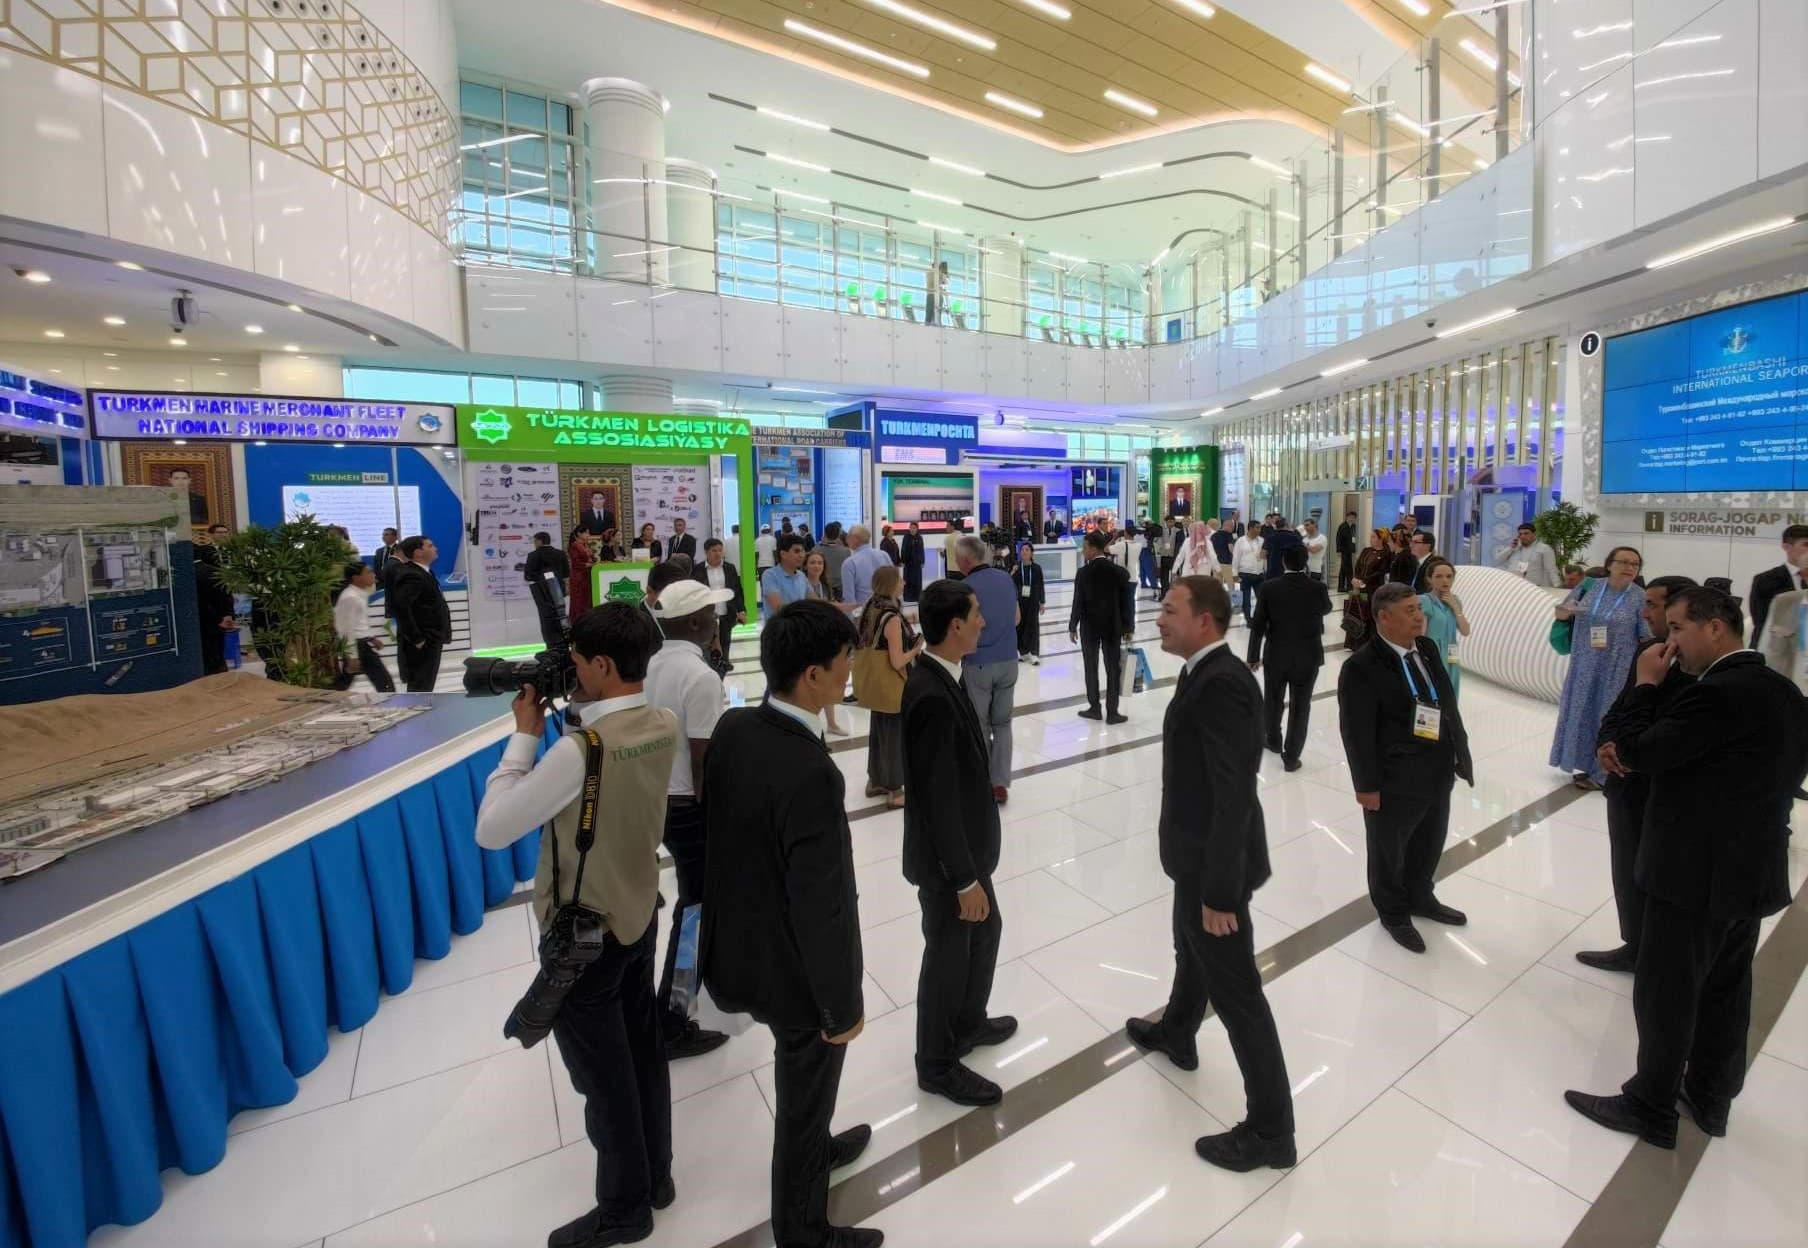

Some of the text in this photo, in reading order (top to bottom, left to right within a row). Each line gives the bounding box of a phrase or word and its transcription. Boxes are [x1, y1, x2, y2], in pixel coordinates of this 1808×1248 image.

[1695, 356, 1787, 379] TURKMENBASHI
[1672, 364, 1808, 394] INTERNATIONAL SEAPOR
[98, 396, 407, 421] TURKMEN MARINE MERCHANT FLEET
[138, 418, 400, 440] NATIONAL SHIPPING COMPANY
[526, 410, 639, 431] TÜRKMEN
[647, 419, 750, 436] LOGISTIKA
[792, 427, 835, 437] ASSOCIATION
[881, 420, 975, 438] TURKMENPOCHTA
[752, 435, 794, 445] ERNATIONAL
[310, 473, 386, 482] TURKMEN LINE
[1669, 511, 1781, 525] SORAG-JOGAP
[1669, 524, 1756, 536] INFORMATION
[582, 802, 593, 830] Nikon
